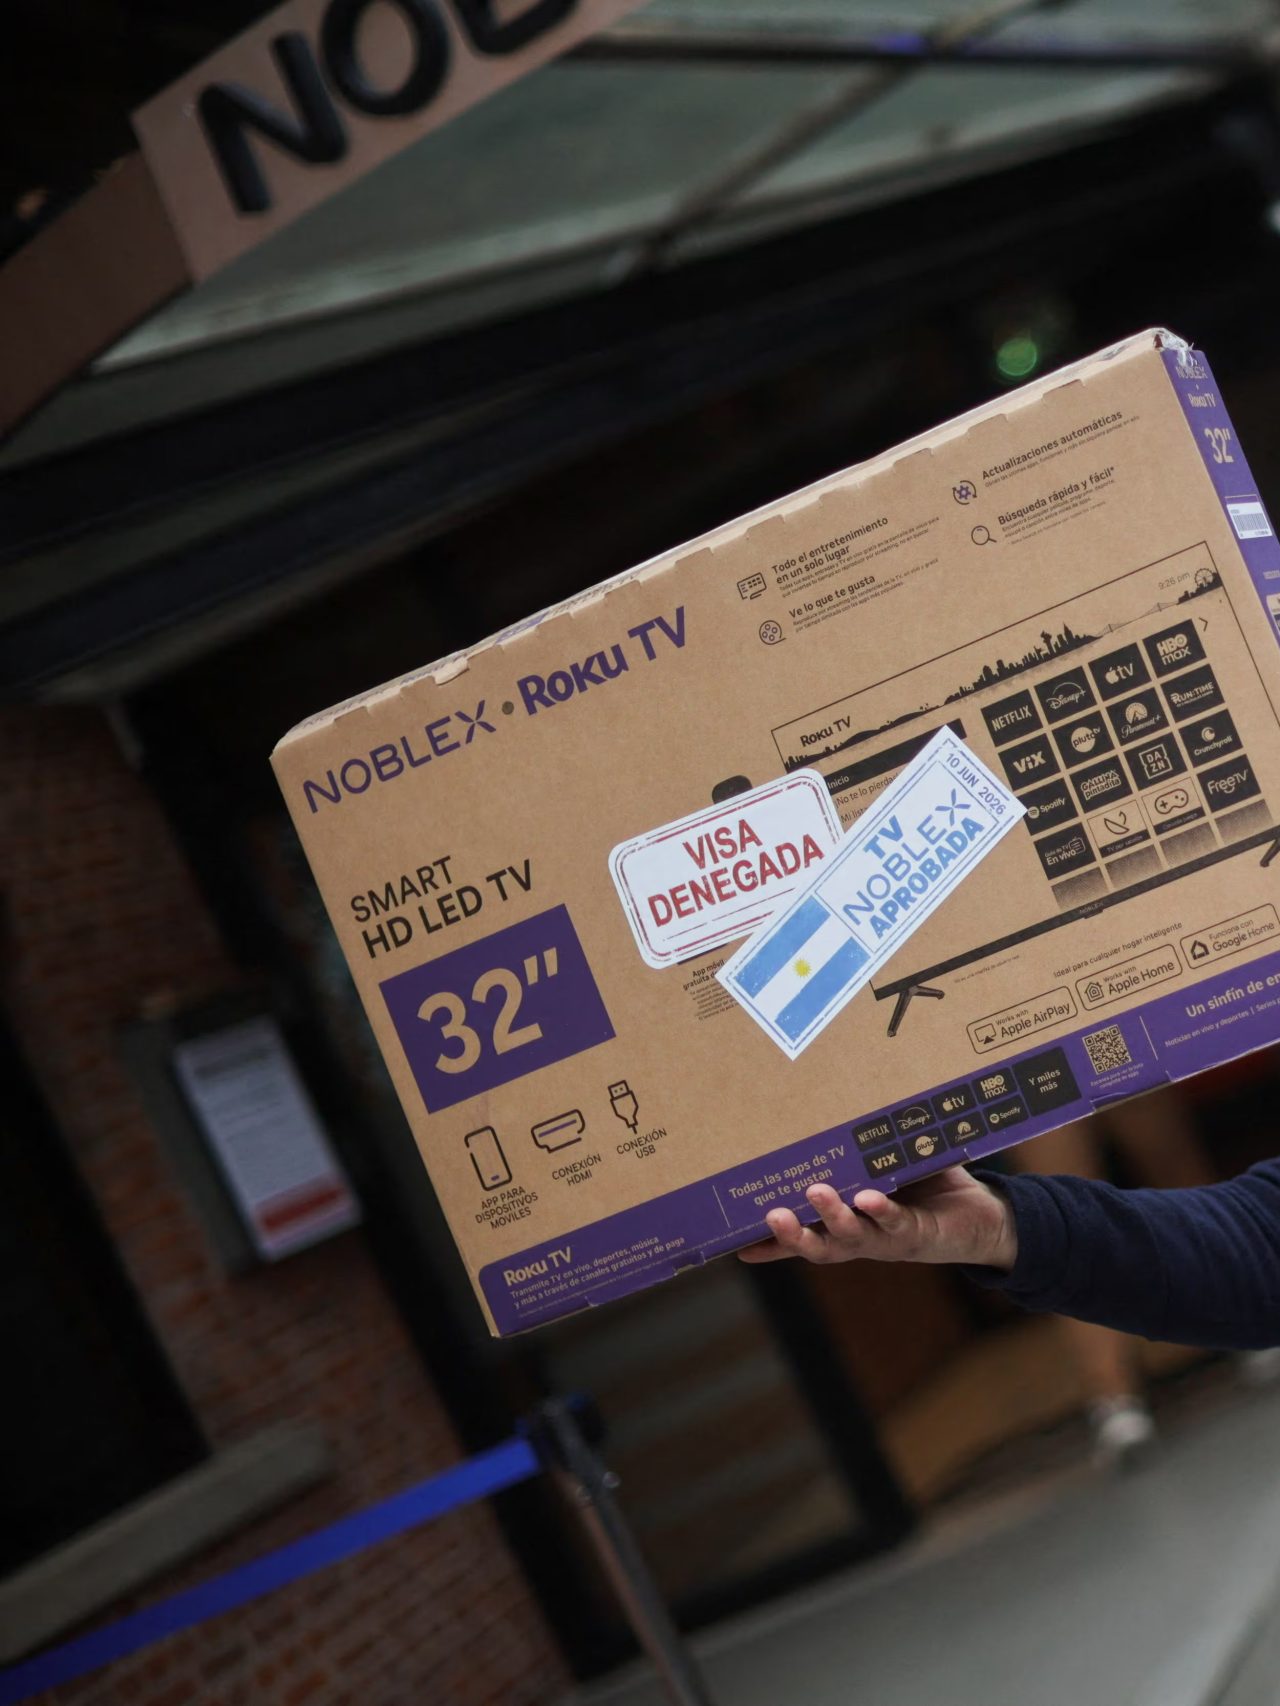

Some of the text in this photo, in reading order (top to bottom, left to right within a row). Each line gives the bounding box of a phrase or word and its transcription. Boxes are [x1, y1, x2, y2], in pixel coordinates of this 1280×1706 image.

[981, 438, 1059, 480] Actualizaciones
[1059, 410, 1122, 445] automáticas
[997, 497, 1047, 526] Búsqueda
[1047, 482, 1080, 504] rápida
[1080, 479, 1087, 490] y
[771, 516, 888, 574] Todo el entretenimiento
[775, 544, 850, 584] en un solo lugar
[788, 574, 875, 618] Ve lo que te gusta
[1156, 632, 1188, 656] HBO
[1161, 645, 1191, 665] max
[1118, 663, 1135, 678] tv
[302, 699, 495, 813] NOBLEX
[516, 640, 628, 715] Roku
[627, 605, 689, 662] TV
[991, 704, 1032, 731] NETFLIX
[799, 715, 851, 747] Roku TV
[1193, 734, 1232, 756] Crunchyroll
[826, 774, 849, 790] Inicio
[848, 791, 858, 800] te
[857, 786, 868, 796] lo
[945, 753, 1006, 815] 10 JUN 2026
[840, 812, 851, 823] Mi
[1039, 796, 1066, 813] Spotify
[682, 816, 762, 871] VISA
[863, 815, 903, 859] TV
[843, 788, 971, 925] NOBLEX
[1046, 847, 1077, 865] En vivo
[349, 855, 454, 923] SMART
[647, 831, 824, 928] DENEGADA
[869, 817, 984, 939] APROBADA
[361, 858, 534, 959] HD LED TV
[1052, 921, 1182, 978] Ideal para cualquier hogar inteligente
[1211, 921, 1275, 953] Google Home
[682, 973, 710, 991] gratuita
[691, 967, 706, 978] App
[1107, 960, 1175, 995] Apple Home
[1185, 1002, 1206, 1018] Un
[1206, 986, 1245, 1010] sinfín
[1245, 979, 1264, 994] de
[999, 1001, 1071, 1038] Apple AirPlay
[980, 1074, 1004, 1091] HBO
[983, 1083, 1007, 1099] max
[1027, 1068, 1061, 1086] Y miles
[1039, 1079, 1058, 1093] más
[998, 1105, 1021, 1119] Spotify
[615, 1126, 667, 1155] CONEXIÓN
[857, 1123, 889, 1143] NETFLIX
[551, 1152, 602, 1180] CONEXIÓN
[634, 1143, 656, 1159] USB
[565, 1168, 592, 1186] HDMI
[728, 1144, 845, 1199] Todas las apps de TV
[753, 1167, 833, 1207] que te gustan
[474, 1191, 538, 1223] DISPOSITIVOS
[480, 1185, 525, 1210] APP PARA
[502, 1245, 572, 1286] Roku TV
[509, 1235, 659, 1298] Transmite TV en vivo, deportes, música
[513, 1236, 685, 1310] y más a través de canales gratuitos y de paga
